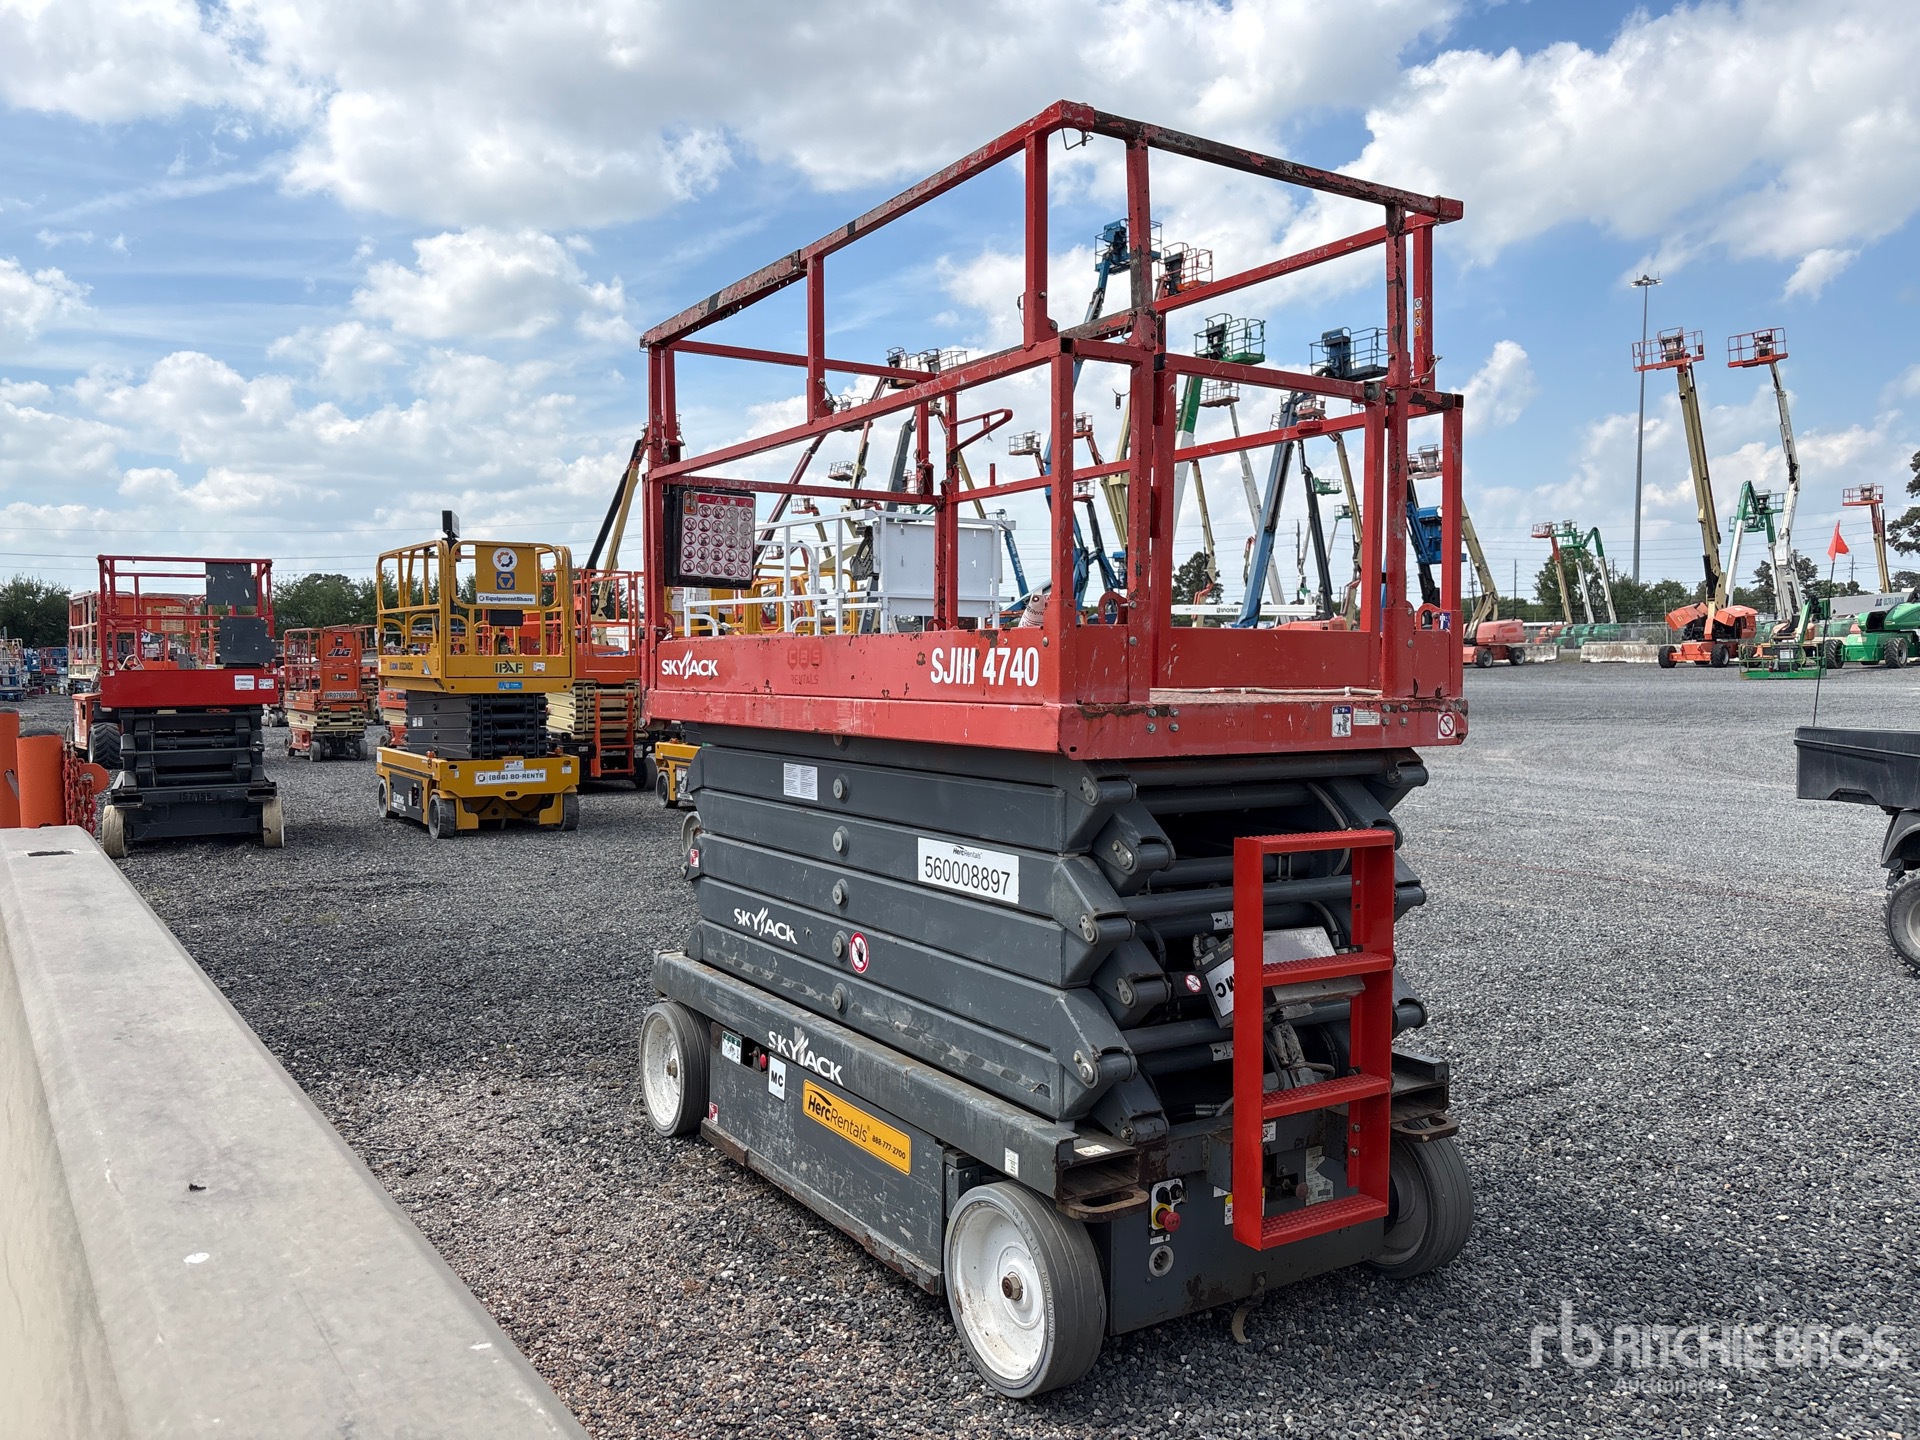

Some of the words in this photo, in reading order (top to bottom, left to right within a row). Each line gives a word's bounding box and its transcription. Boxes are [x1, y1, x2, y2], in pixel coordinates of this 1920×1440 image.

[327, 648, 352, 657] JLG
[495, 661, 523, 674] IPAF
[661, 649, 719, 680] SKYJACK
[982, 646, 1040, 687] 4740
[952, 847, 982, 859] HercRentals
[925, 855, 1011, 896] 560008897
[733, 906, 798, 945] SKYJACK
[768, 1030, 844, 1086] SKYJACK
[770, 1070, 784, 1088] MC
[807, 1094, 869, 1144] HercRentals
[872, 1135, 906, 1160] 888-777-2700
